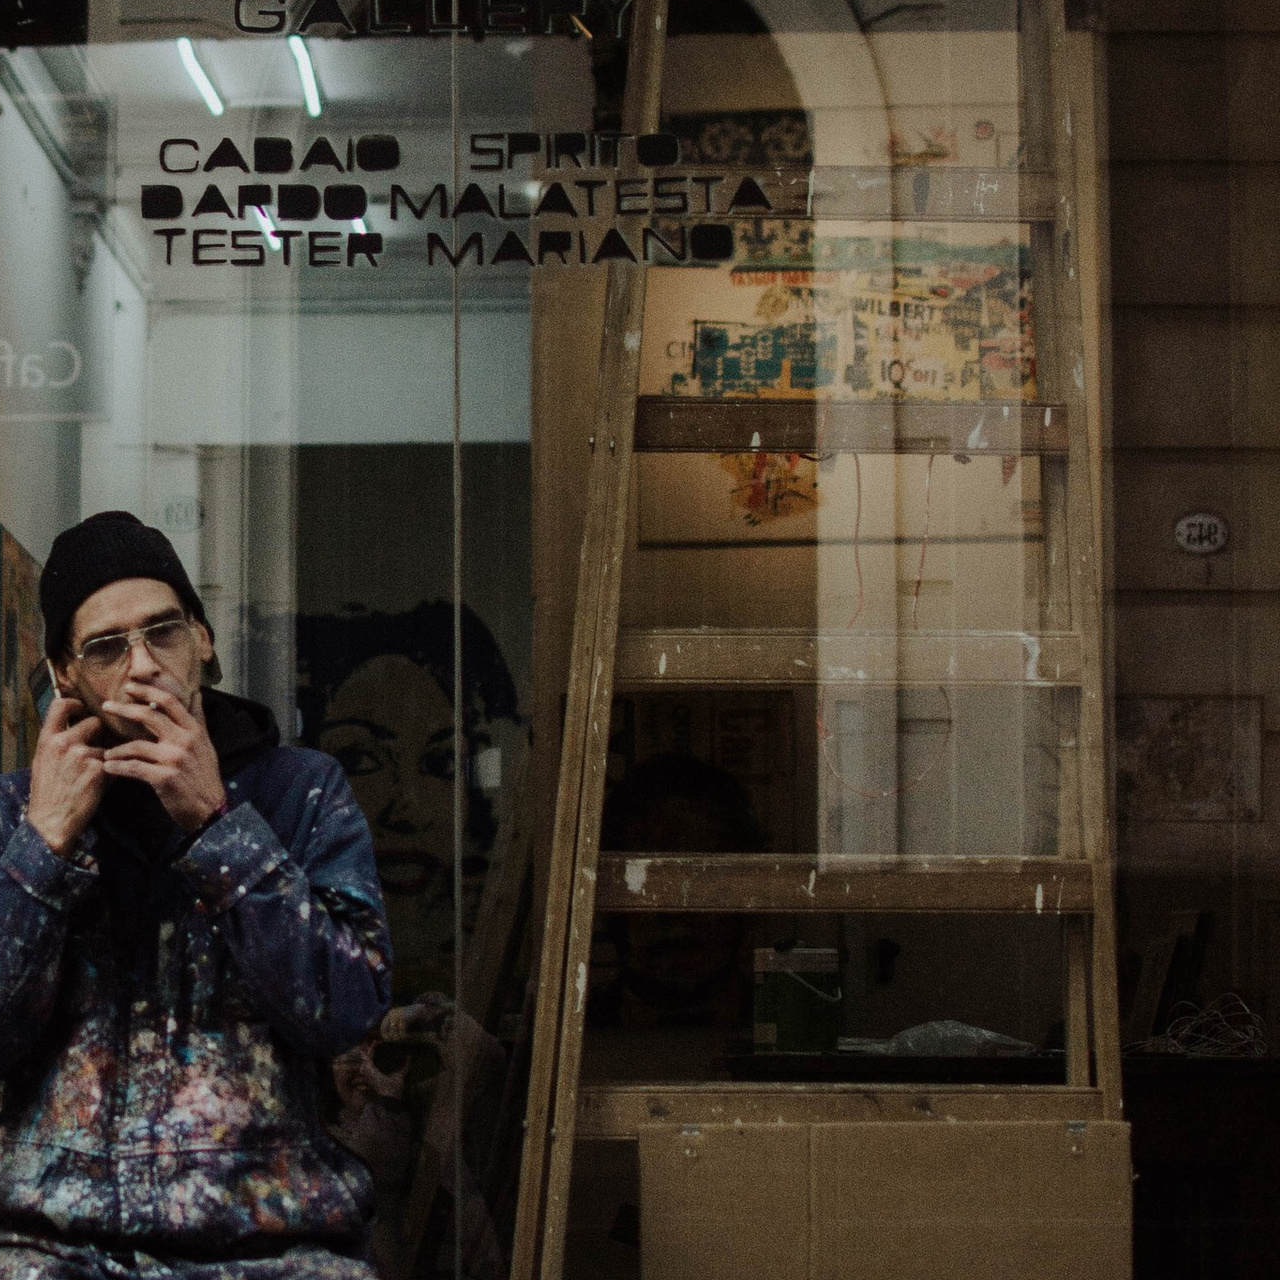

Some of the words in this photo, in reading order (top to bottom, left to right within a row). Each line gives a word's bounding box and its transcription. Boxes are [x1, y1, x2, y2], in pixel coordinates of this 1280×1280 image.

[158, 135, 400, 174] CABAIO
[469, 132, 681, 171] SPIRITO
[141, 183, 368, 220] DARDO
[390, 176, 774, 220] MALATESTA
[153, 228, 384, 267] TESTER
[426, 224, 734, 267] MARIANO
